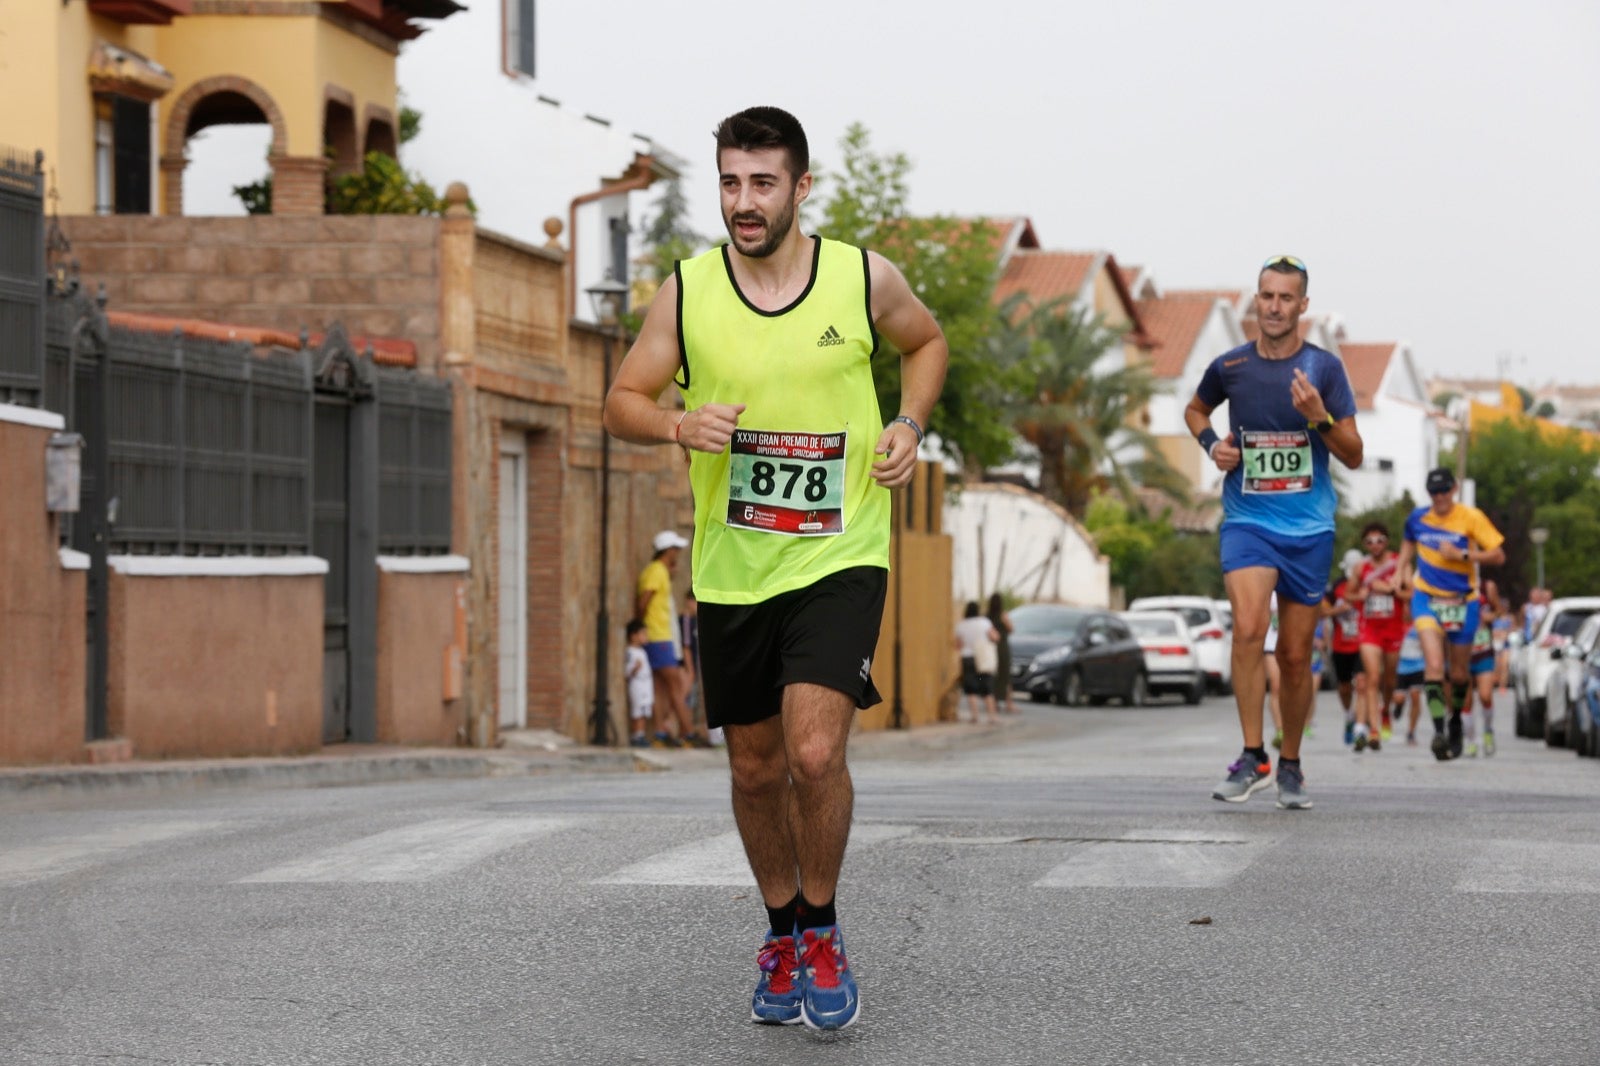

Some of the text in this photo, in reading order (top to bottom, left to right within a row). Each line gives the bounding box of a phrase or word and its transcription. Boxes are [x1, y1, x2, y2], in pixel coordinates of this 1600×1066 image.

[816, 337, 845, 347] adidas
[737, 432, 840, 449] XXXII GRAN PREMIO DE FONDO
[757, 446, 788, 457] DIPUTACIÓN
[793, 449, 824, 459] CRUZCAMPO
[1255, 451, 1301, 473] 109
[751, 461, 827, 503] 878
